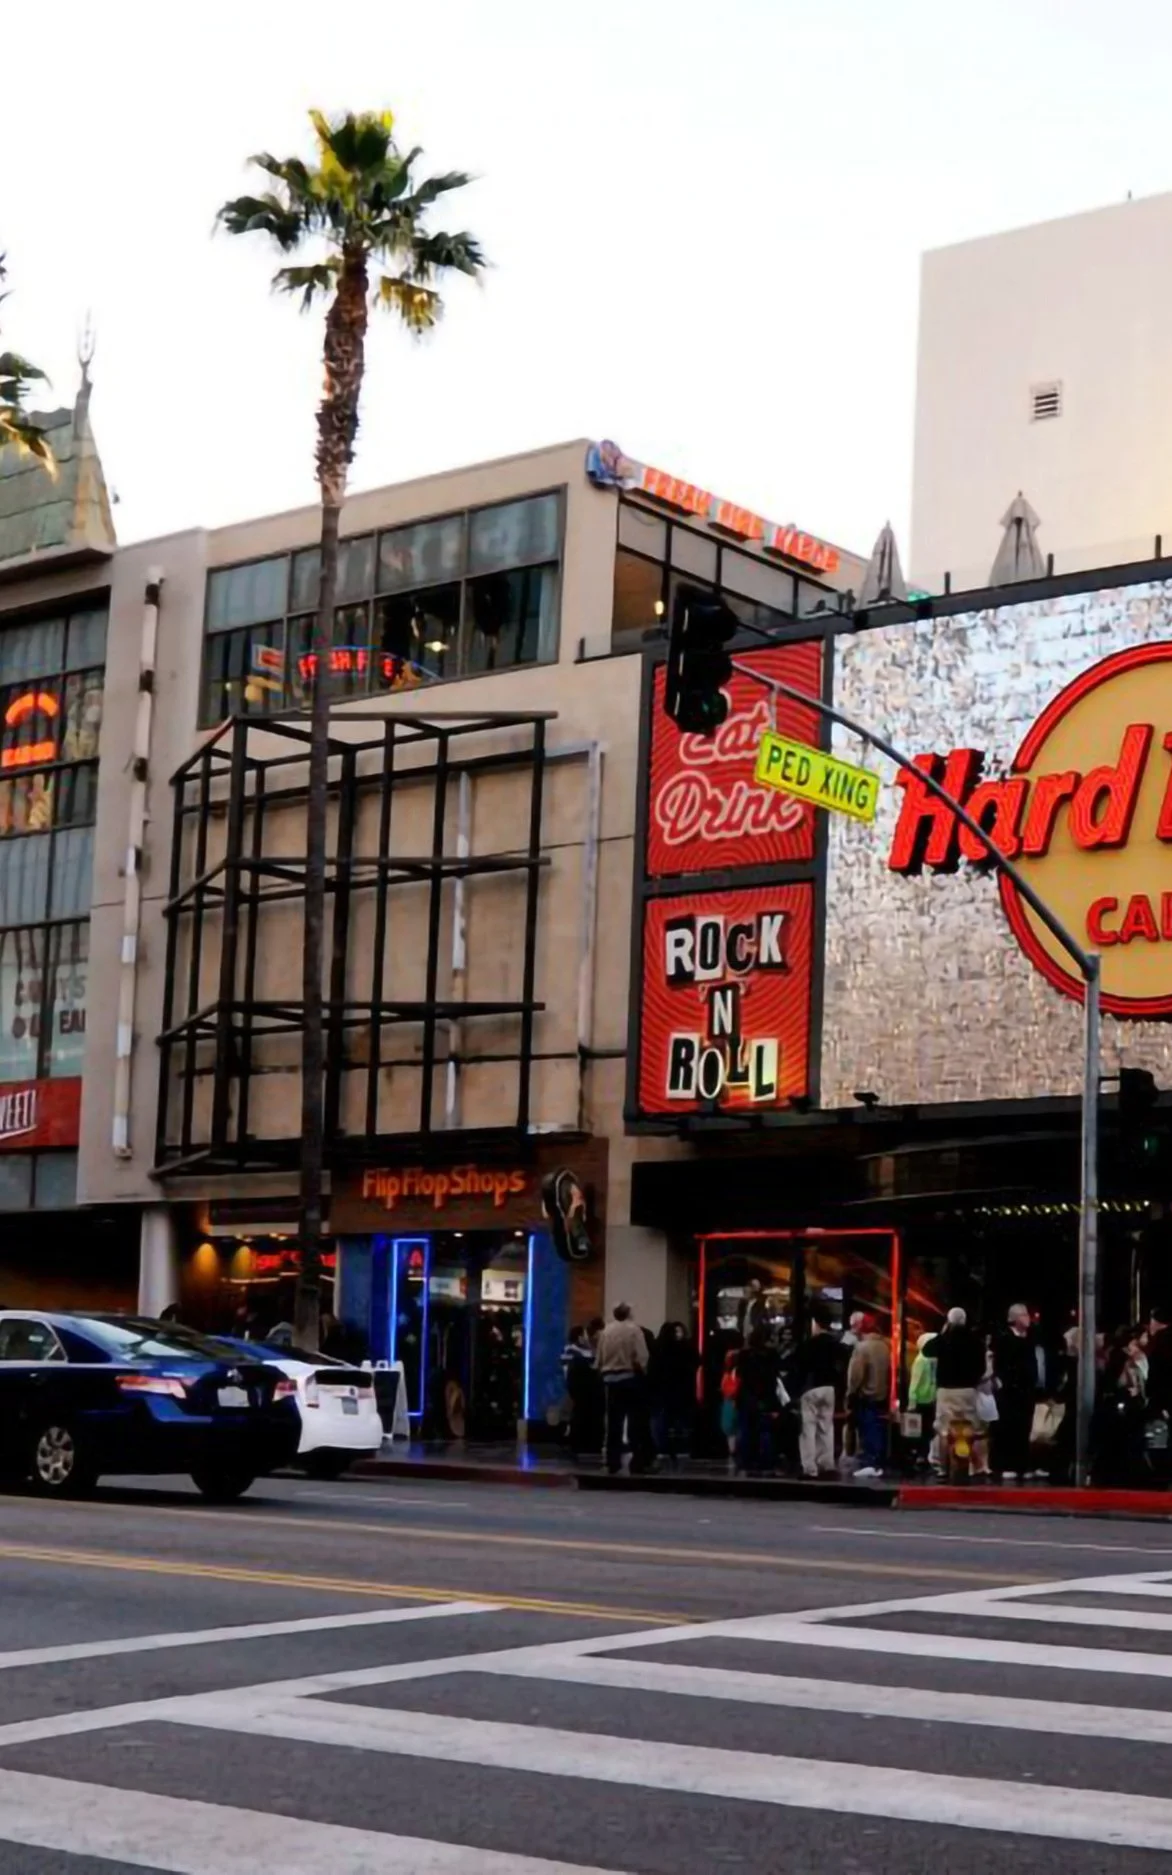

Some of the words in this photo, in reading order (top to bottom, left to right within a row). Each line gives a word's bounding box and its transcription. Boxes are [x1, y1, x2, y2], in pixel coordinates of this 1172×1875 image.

[765, 744, 811, 787] PED
[819, 764, 871, 809] XING
[888, 722, 1155, 876] Hard
[665, 914, 785, 977] ROCK
[668, 1036, 776, 1098] ROLL
